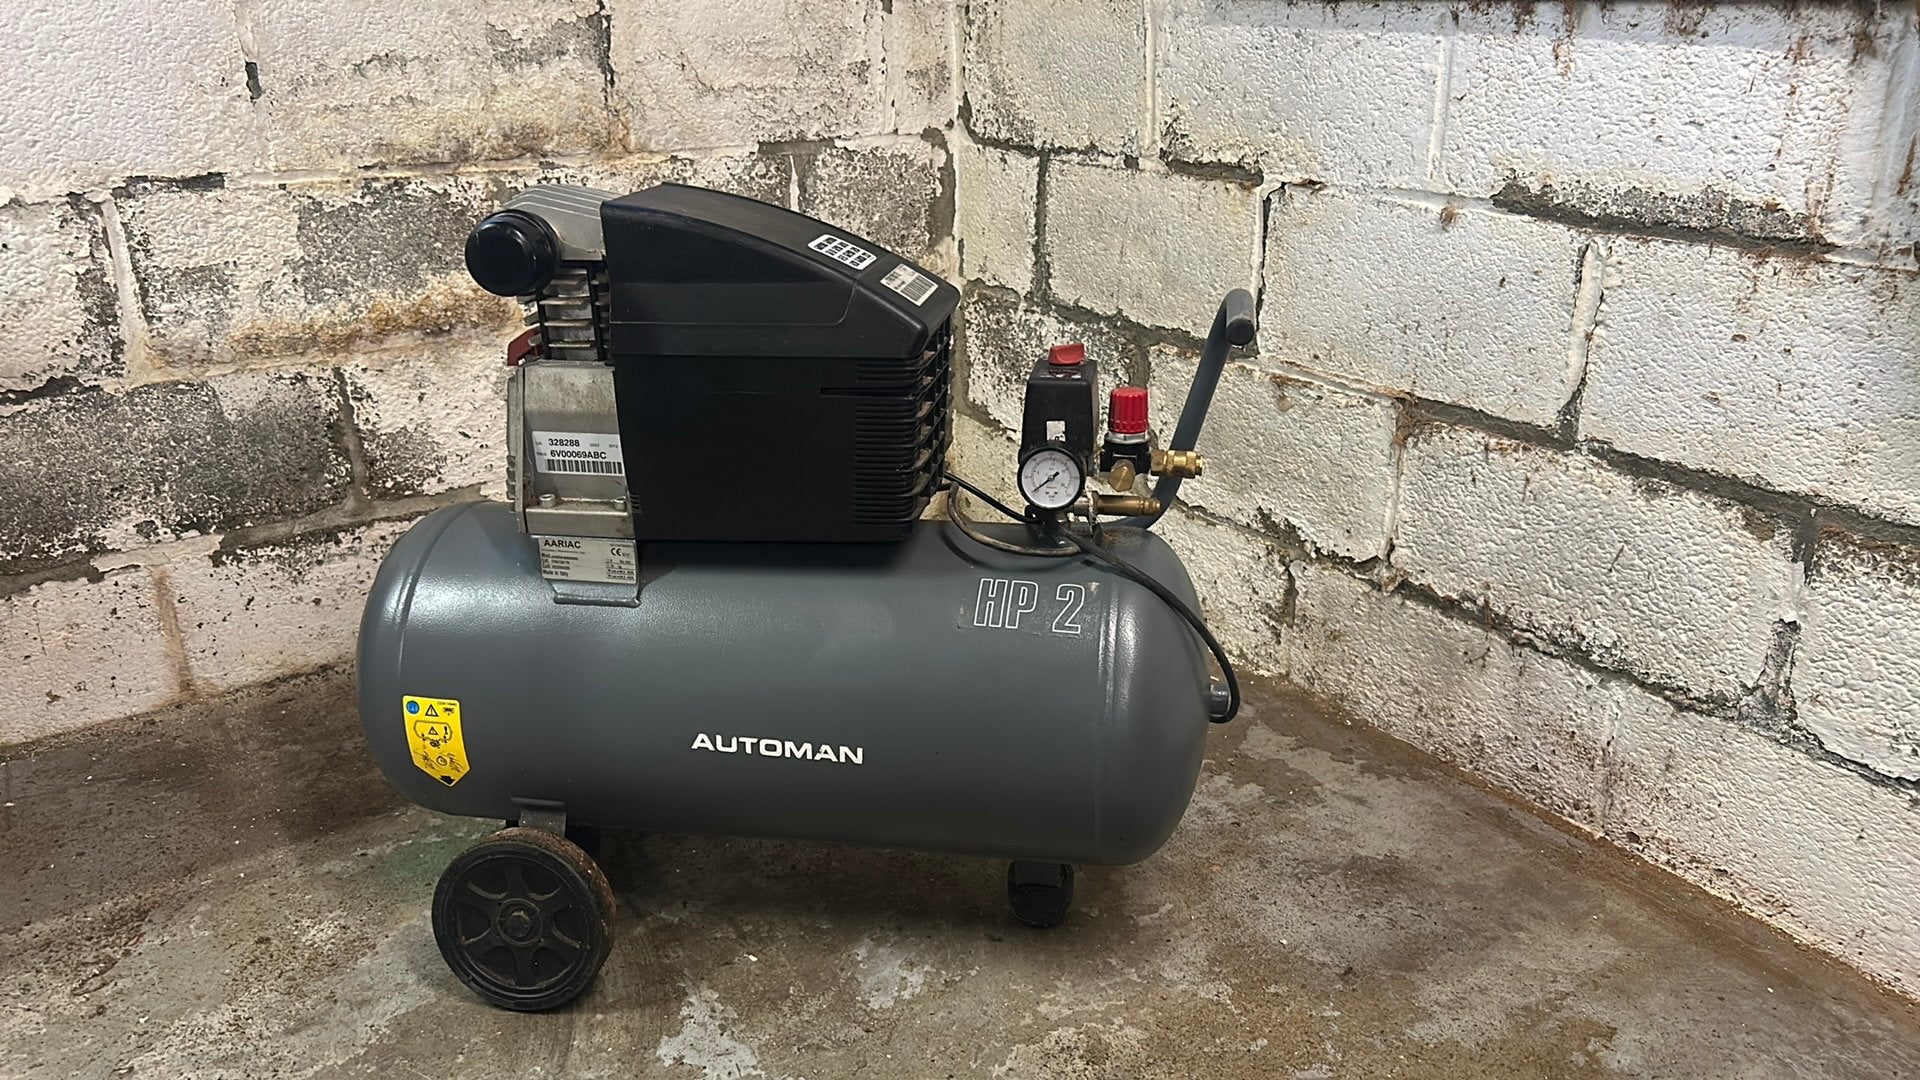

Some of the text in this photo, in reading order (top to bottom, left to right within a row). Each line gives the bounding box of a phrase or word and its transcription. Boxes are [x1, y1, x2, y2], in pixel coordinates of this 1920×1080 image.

[548, 438, 580, 447] 328288
[550, 449, 607, 460] 6V00069ABC
[544, 539, 581, 549] AARIAC
[973, 578, 1085, 634] HP 2
[691, 733, 863, 765] AUTOMAN
